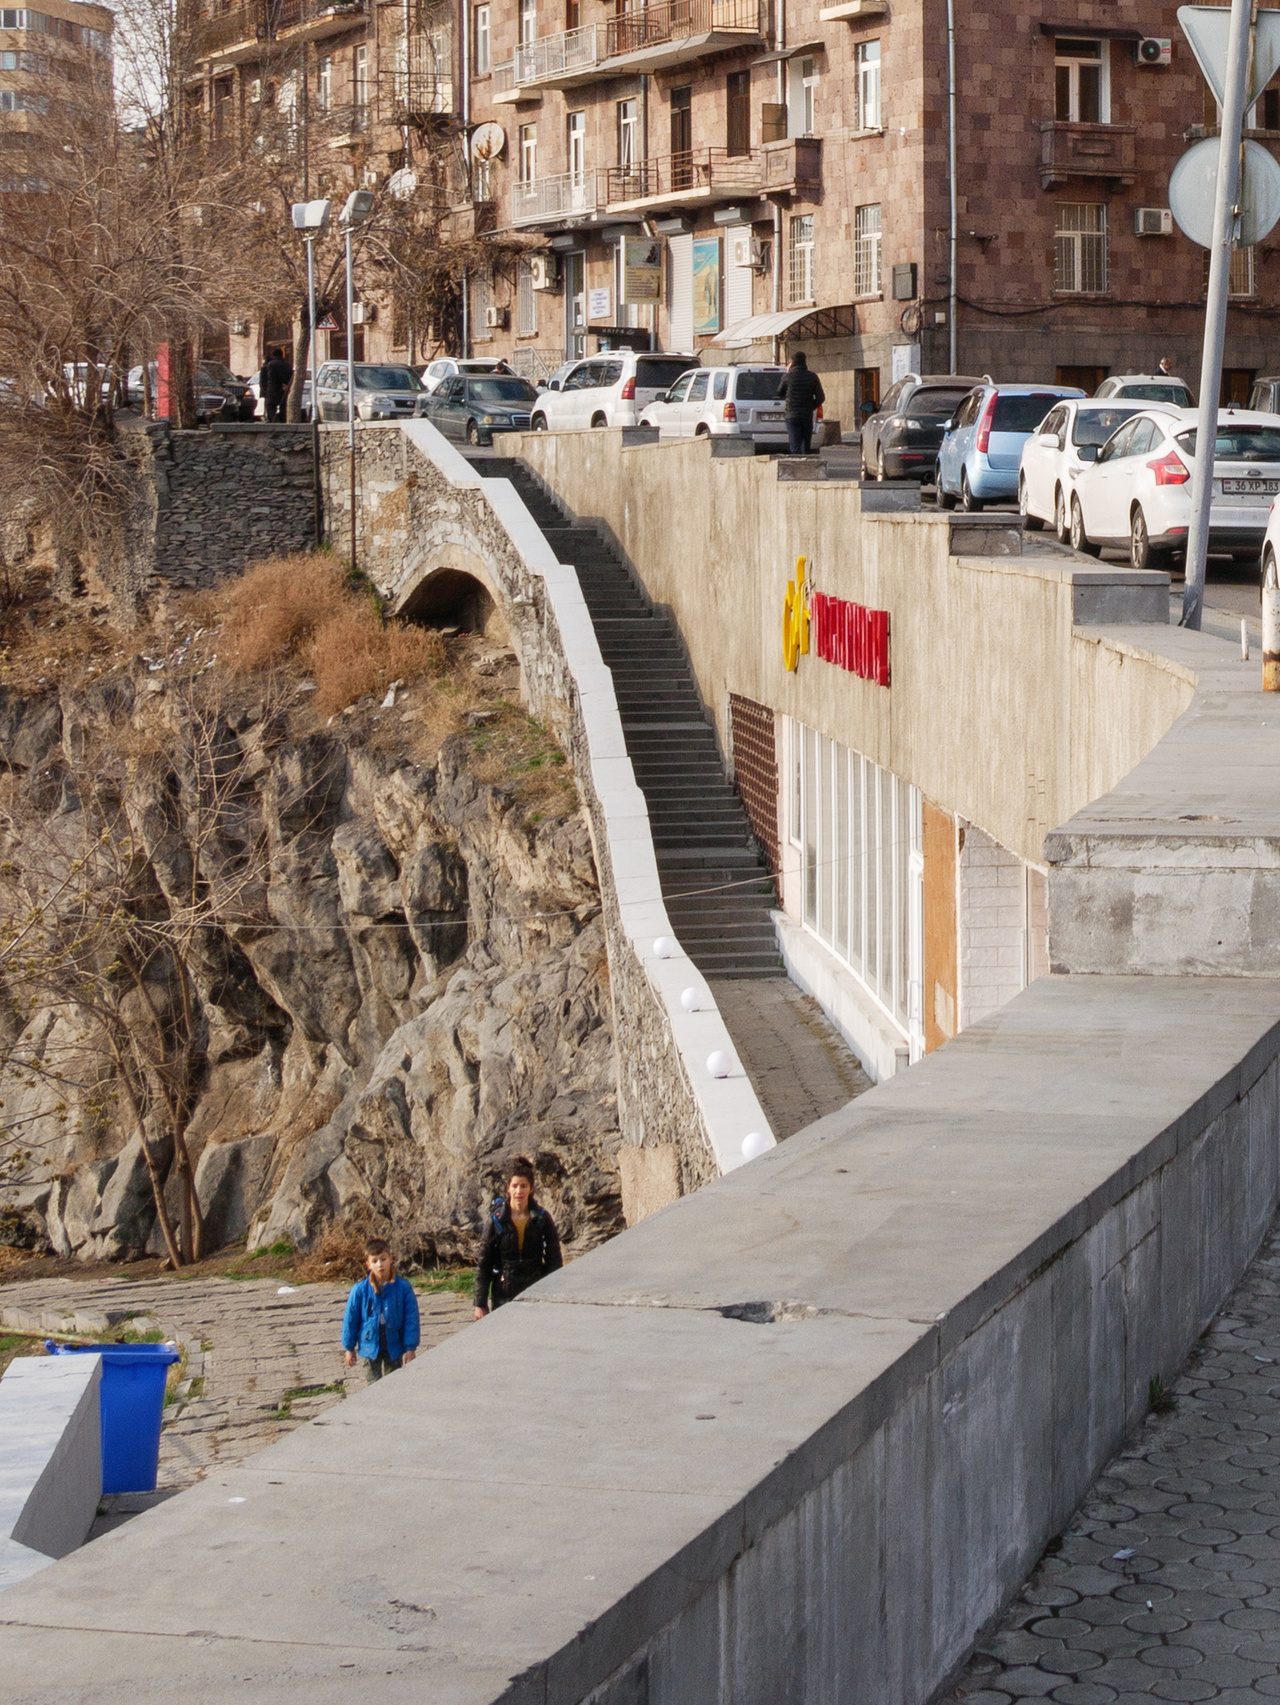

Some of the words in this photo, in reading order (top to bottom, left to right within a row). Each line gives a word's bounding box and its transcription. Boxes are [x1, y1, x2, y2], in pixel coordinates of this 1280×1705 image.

[1235, 480, 1246, 491] 36
[1248, 481, 1261, 491] XP
[1263, 481, 1279, 492] 183
